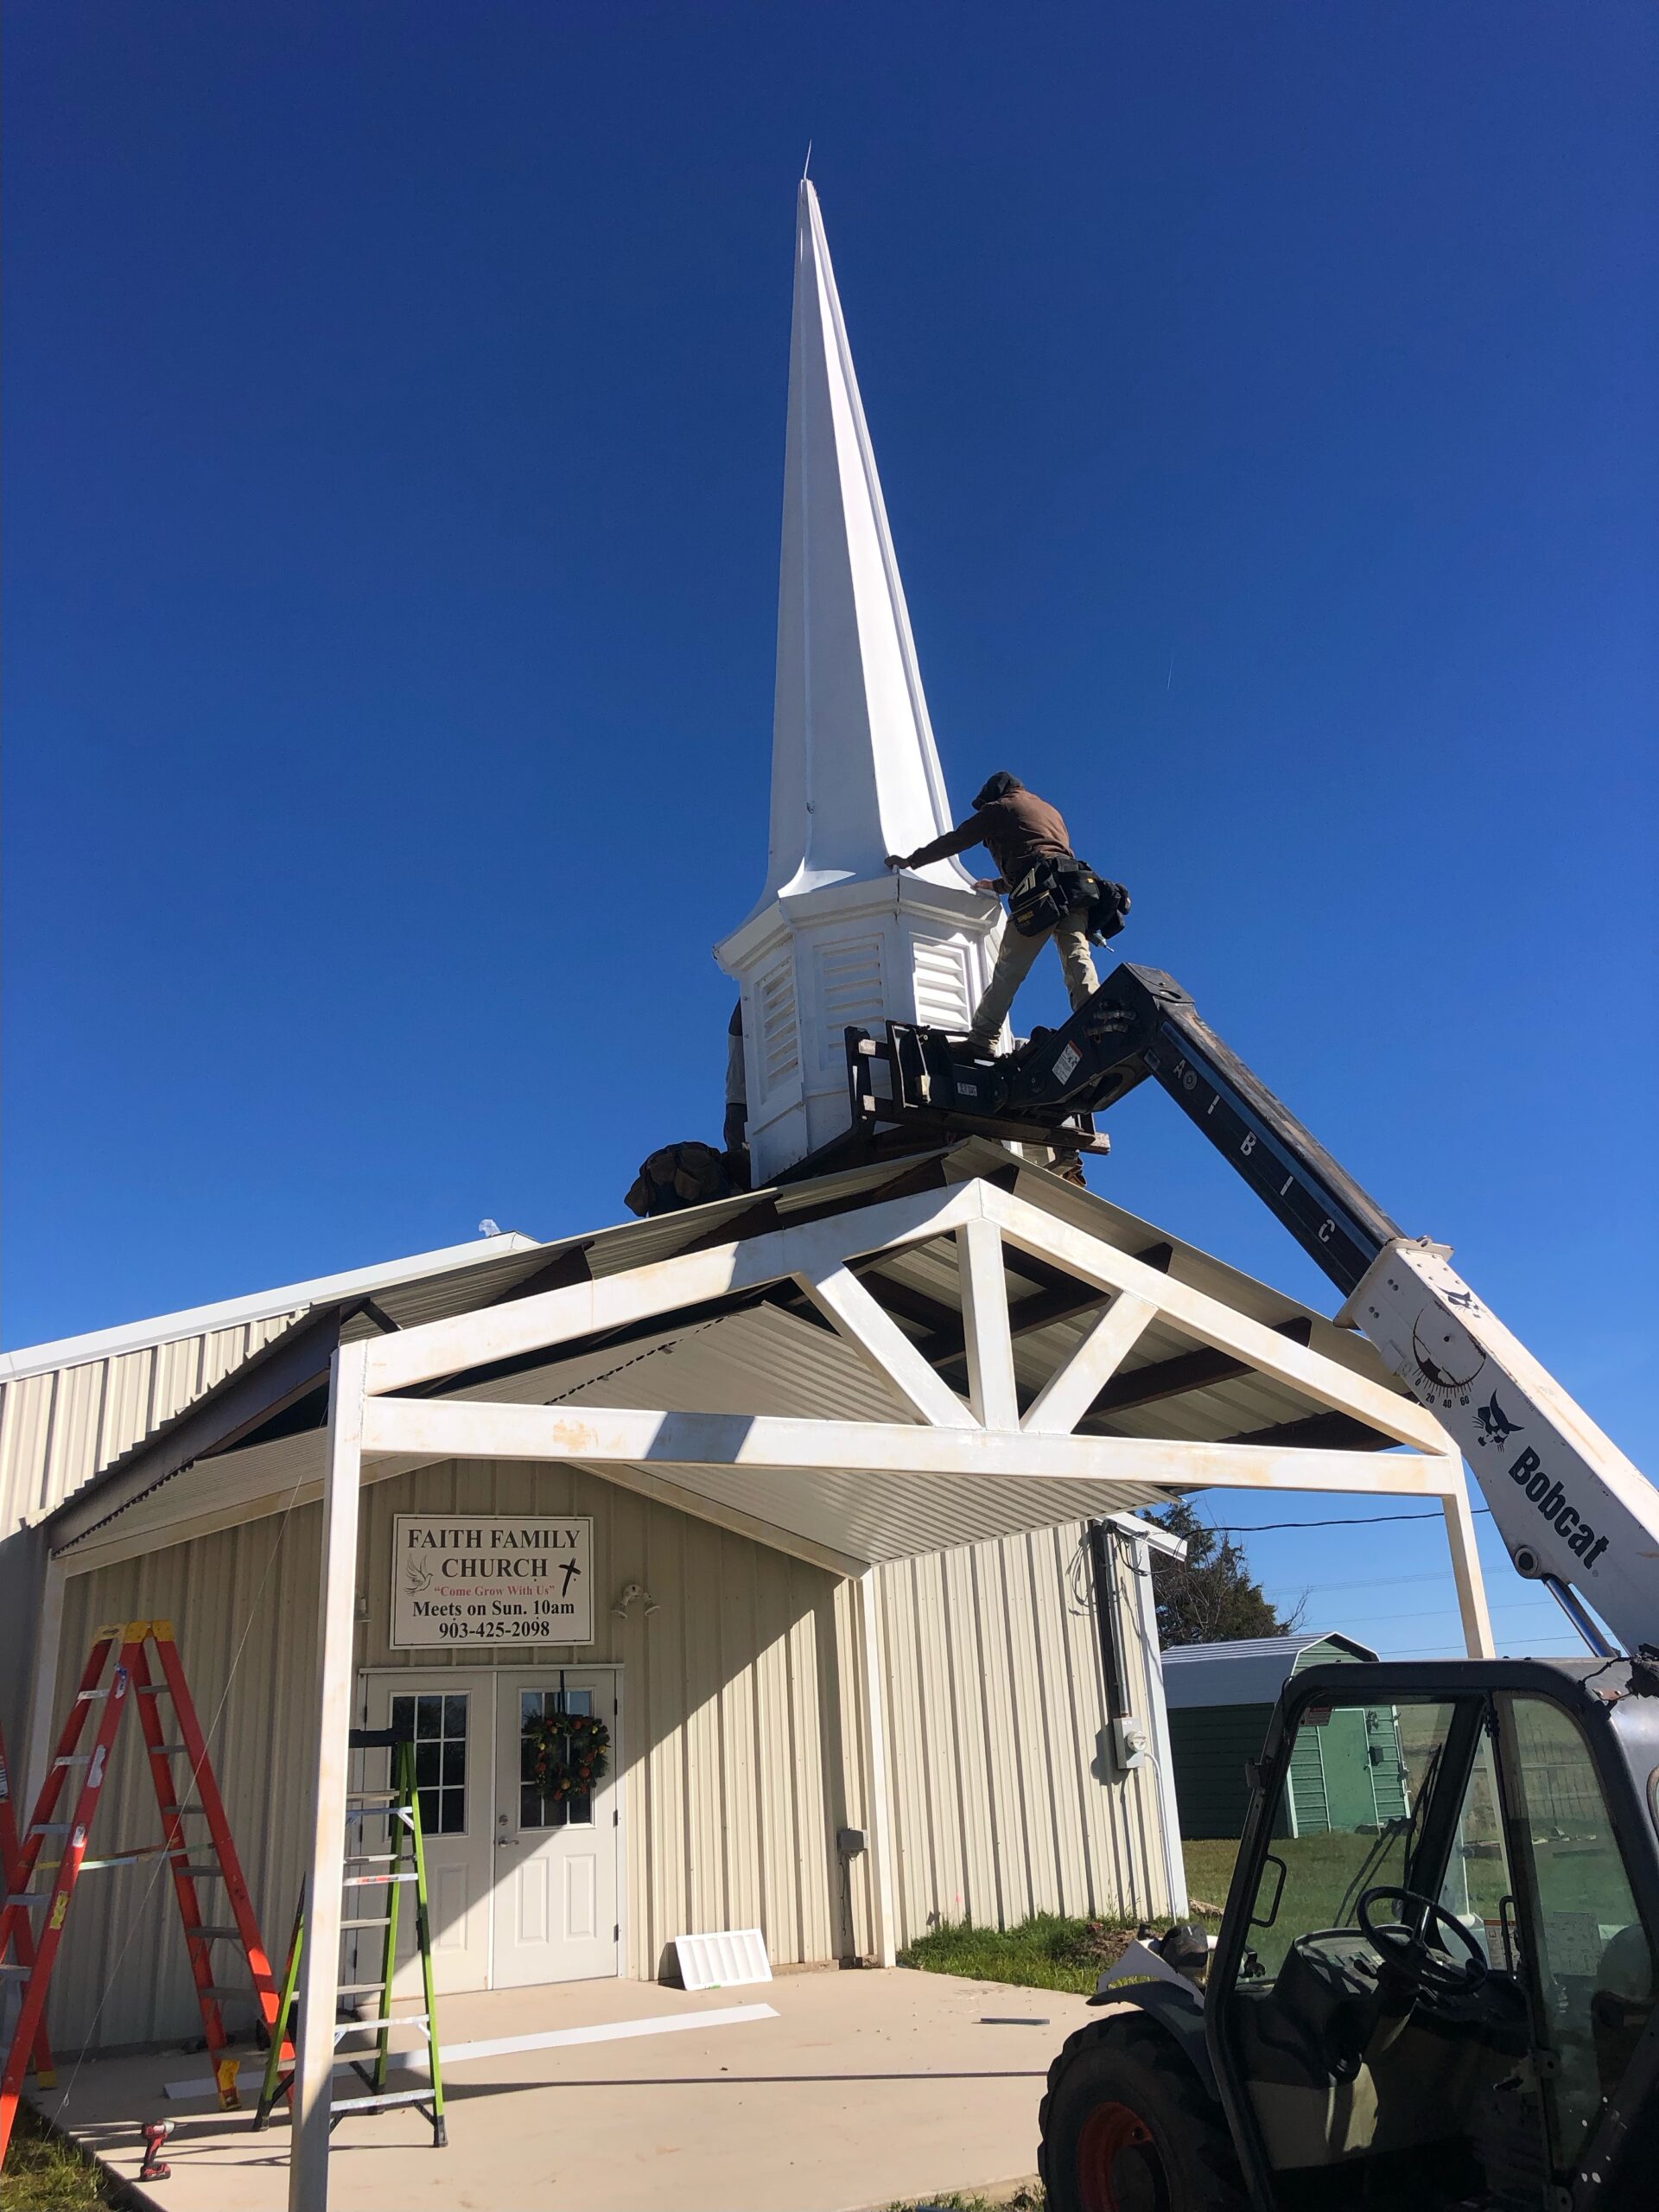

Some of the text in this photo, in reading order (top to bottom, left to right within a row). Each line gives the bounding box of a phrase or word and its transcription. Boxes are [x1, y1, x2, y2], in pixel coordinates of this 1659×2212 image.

[1241, 1131, 1257, 1156] B
[1319, 1218, 1335, 1243] C
[1426, 1393, 1435, 1404] 20
[1442, 1399, 1452, 1408] 40
[1459, 1395, 1470, 1406] 60
[1508, 1446, 1610, 1569] Bobcat
[408, 1529, 581, 1548] FAITH FAMILY
[442, 1558, 549, 1578] CHURCH
[474, 1586, 505, 1597] Grow
[507, 1585, 533, 1596] With
[412, 1600, 575, 1617] Meets on Sun. 10am
[439, 1621, 550, 1638] 903-425-2098
